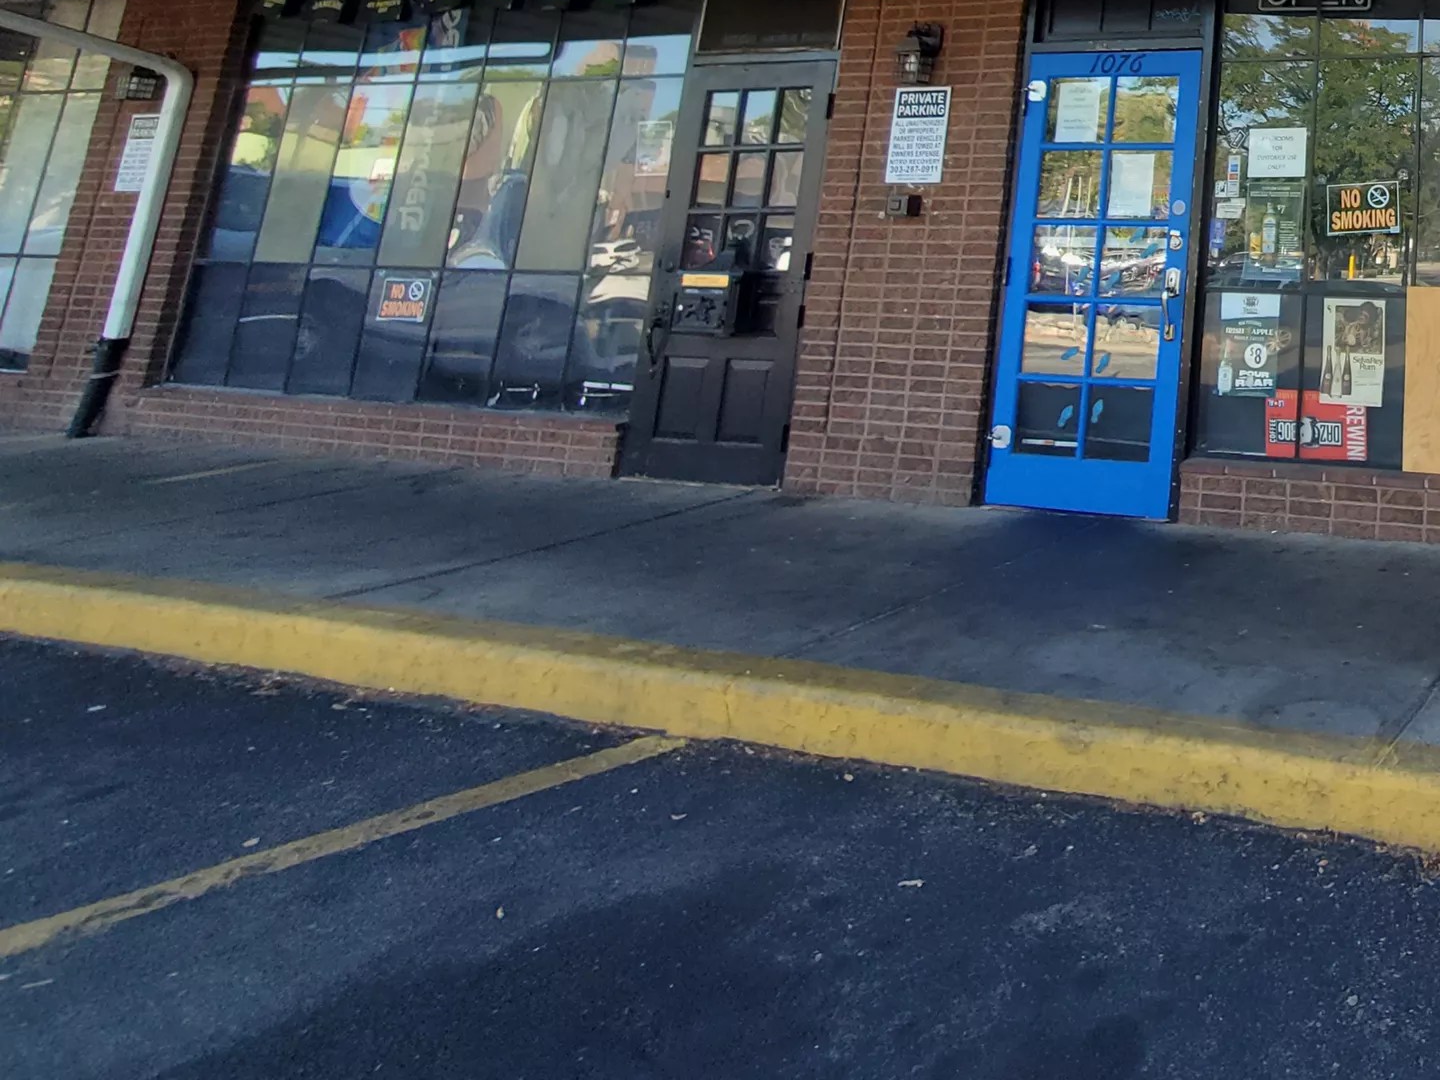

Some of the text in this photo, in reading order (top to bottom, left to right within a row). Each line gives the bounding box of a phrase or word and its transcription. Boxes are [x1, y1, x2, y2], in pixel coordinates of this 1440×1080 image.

[1089, 54, 1146, 73] 1076
[901, 92, 945, 104] PRIVATE
[898, 104, 945, 116] PARKING
[1341, 189, 1361, 208] NO
[1331, 208, 1396, 230] SMOKING
[390, 284, 405, 299] NO
[381, 301, 424, 317] SMOKING
[1239, 370, 1270, 378] POUR
